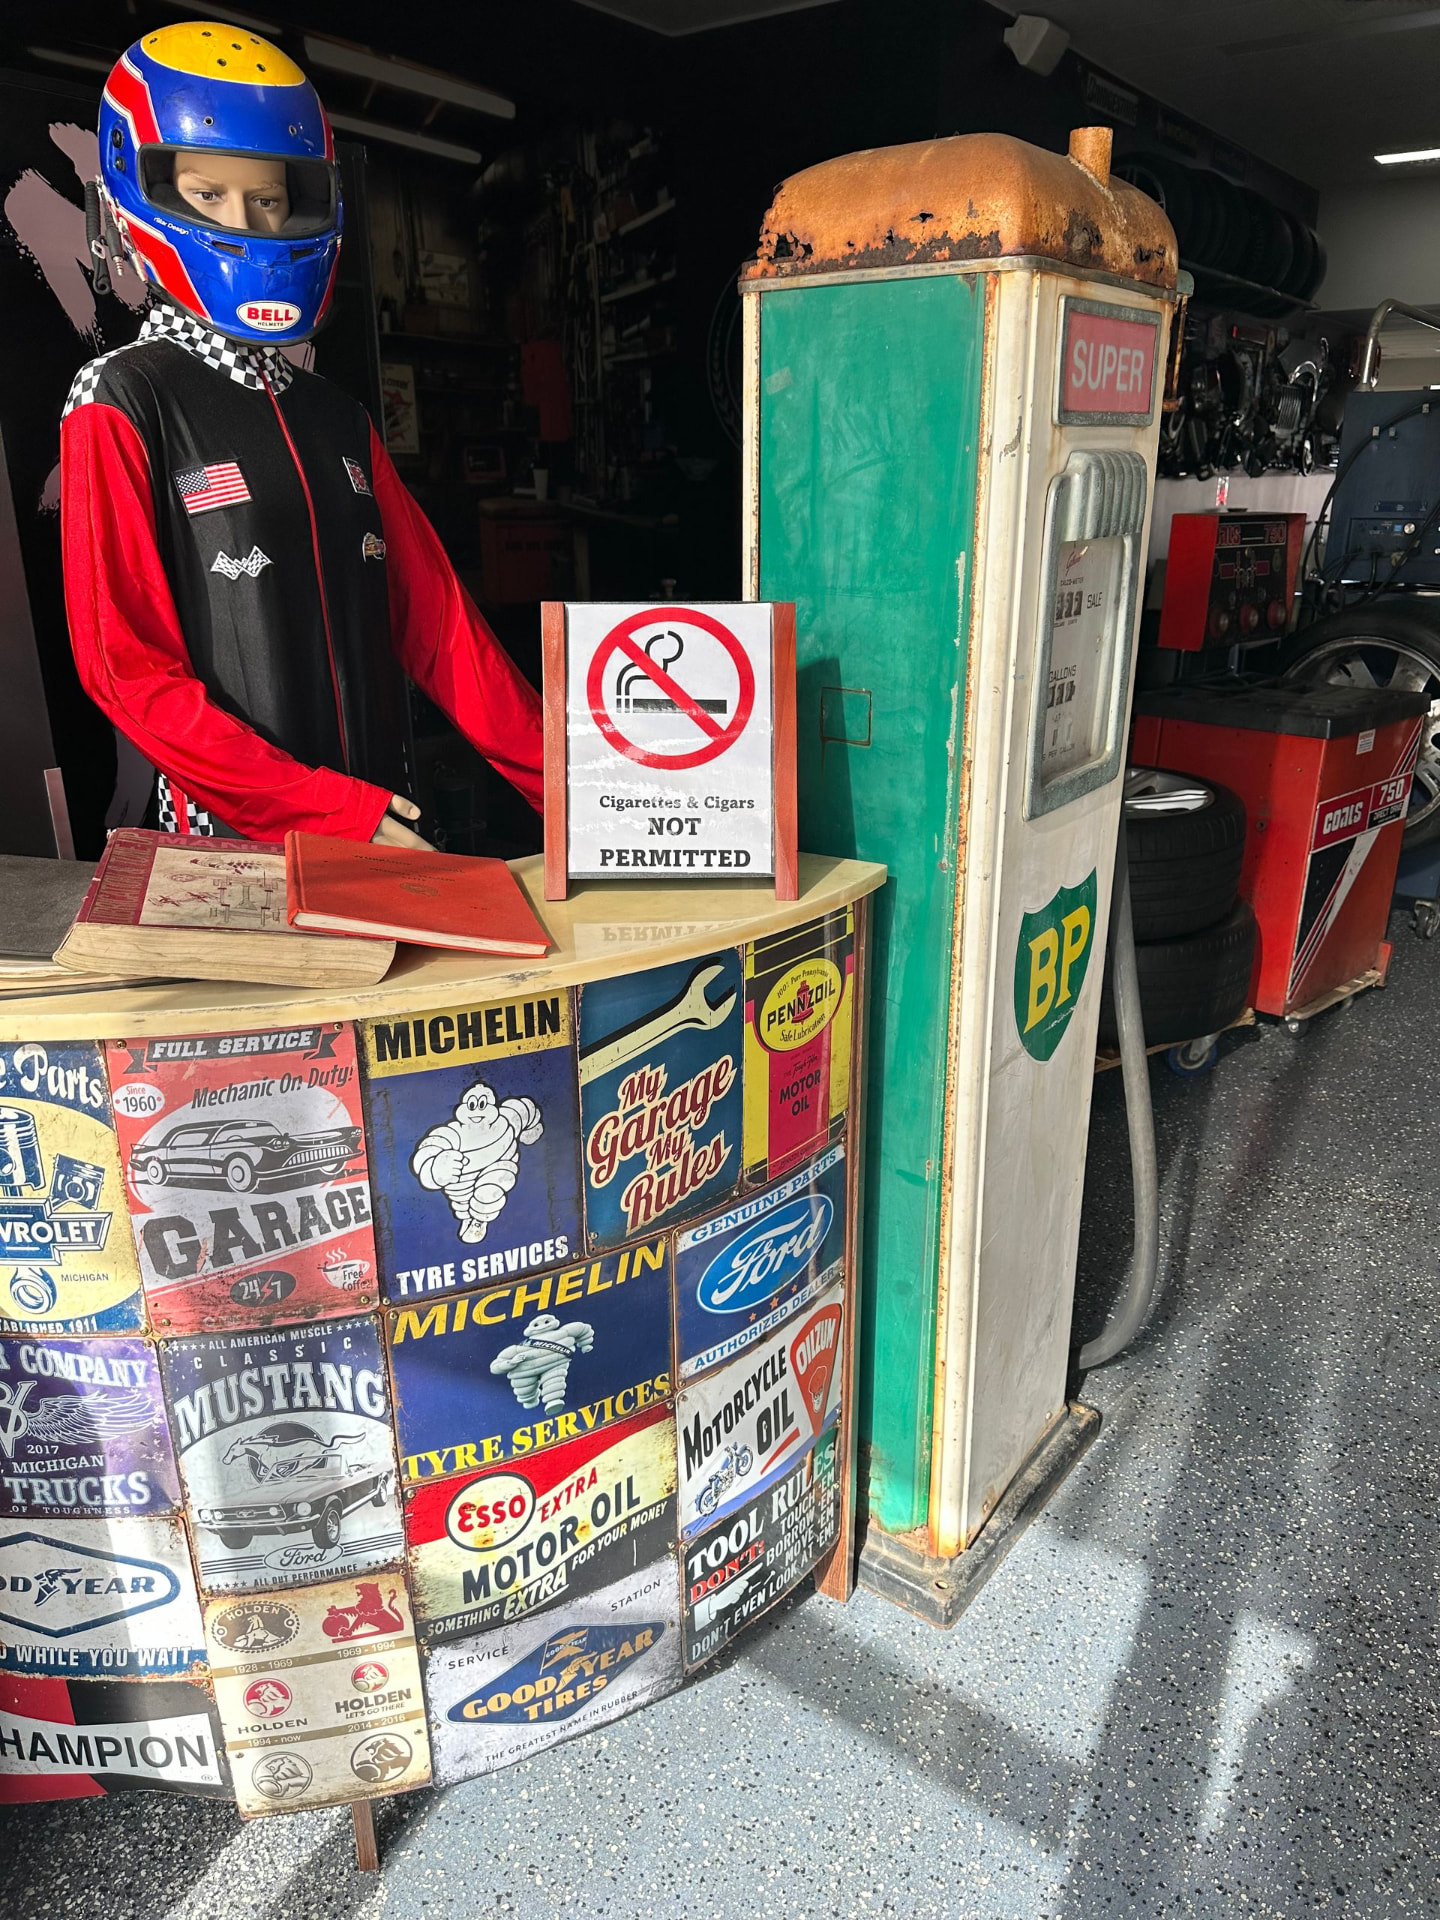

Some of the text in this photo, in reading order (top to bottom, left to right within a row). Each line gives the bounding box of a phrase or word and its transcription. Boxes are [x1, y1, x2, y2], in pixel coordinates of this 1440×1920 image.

[247, 307, 293, 321] BELL
[1071, 339, 1145, 393] SUPER
[1086, 591, 1102, 609] SALE
[1048, 664, 1077, 683] GALLONS
[599, 795, 755, 812] Cigarettes & Cigars
[1379, 778, 1405, 806] 750
[647, 817, 702, 836] NOT
[599, 849, 752, 868] PERMITTED
[1023, 904, 1090, 1034] BP
[767, 979, 836, 1032] PENNZOIL
[152, 1030, 314, 1059] FULL SERVICE
[374, 997, 561, 1063] MICHELIN
[779, 1029, 793, 1043] Safe
[13, 1043, 104, 1108] Parts
[126, 1085, 146, 1095] Since
[191, 1064, 354, 1110] Mechanic On Duty!
[620, 1066, 664, 1110] My
[779, 1068, 821, 1105] MOTOR
[122, 1095, 157, 1112] 1960
[590, 1058, 734, 1184] Garage
[791, 1095, 810, 1117] OIL
[649, 1128, 690, 1169] My
[622, 1134, 727, 1230] Rules
[691, 1188, 788, 1243] GENUINE
[791, 1150, 838, 1191] PARTS
[142, 1186, 372, 1280] GARAGE
[396, 1236, 569, 1296] TYRE SERVICES
[711, 1204, 826, 1306] Ford
[61, 1272, 109, 1282] MICHIGAN
[342, 1269, 364, 1280] Free
[392, 1240, 666, 1344] MICHELIN
[0, 1315, 98, 1334] ABLISHED 1911
[208, 1324, 333, 1350] ALL AMERICAN MUSCLE
[694, 1268, 836, 1371] AUTHORIZED DEALER
[20, 1344, 148, 1388] COMPANY
[532, 1340, 571, 1355] MICHELIN
[173, 1361, 386, 1449] MUSTANG
[683, 1345, 788, 1482] MOTORCYCLE
[756, 1388, 796, 1456] OIL
[402, 1372, 672, 1481] TYRE SERVICES
[12, 1454, 105, 1474] MICHIGAN
[27, 1445, 60, 1455] 2017
[3, 1469, 151, 1506] TRUCKS
[540, 1467, 598, 1524] EXTRA
[11, 1505, 131, 1515] OF TOUGHNESS
[688, 1443, 835, 1581] TOOL RULES
[780, 1488, 815, 1535] TOUCH
[280, 1545, 327, 1567] Ford
[462, 1475, 641, 1604] MOTOR OIL
[766, 1510, 815, 1567] BORROW
[785, 1524, 814, 1566] MOVE
[253, 1563, 358, 1587] ALL OUT PERFORMANCE
[427, 1501, 667, 1637] SOMETHING EXTRA FOR YOUR MONEY
[226, 1605, 281, 1621] HOLDEN
[692, 1615, 731, 1660] DON'T
[733, 1588, 766, 1626] EVEN
[769, 1561, 798, 1598] LOOK
[801, 1542, 814, 1568] AT
[448, 1578, 662, 1670] SERVICE STATION
[15, 1644, 80, 1666] WHILE
[88, 1648, 129, 1667] YOU
[138, 1646, 192, 1665] WAIT
[337, 1646, 362, 1658] 1969
[371, 1641, 396, 1653] 1994
[545, 1635, 587, 1658] GOODYEAR
[233, 1663, 258, 1675] 1928
[268, 1658, 293, 1670] 1969
[462, 1627, 654, 1719] GOODYEAR
[335, 1687, 412, 1714] HOLDEN
[346, 1702, 406, 1720] LET'S GO THERE
[524, 1674, 608, 1721] TIRES
[237, 1718, 308, 1735] HOLDEN
[247, 1737, 272, 1748] 1994
[281, 1734, 302, 1744] now
[347, 1721, 372, 1733] 2014
[381, 1713, 406, 1726] 2016
[485, 1689, 639, 1763] THE GREATEST NAME IN RUBBER
